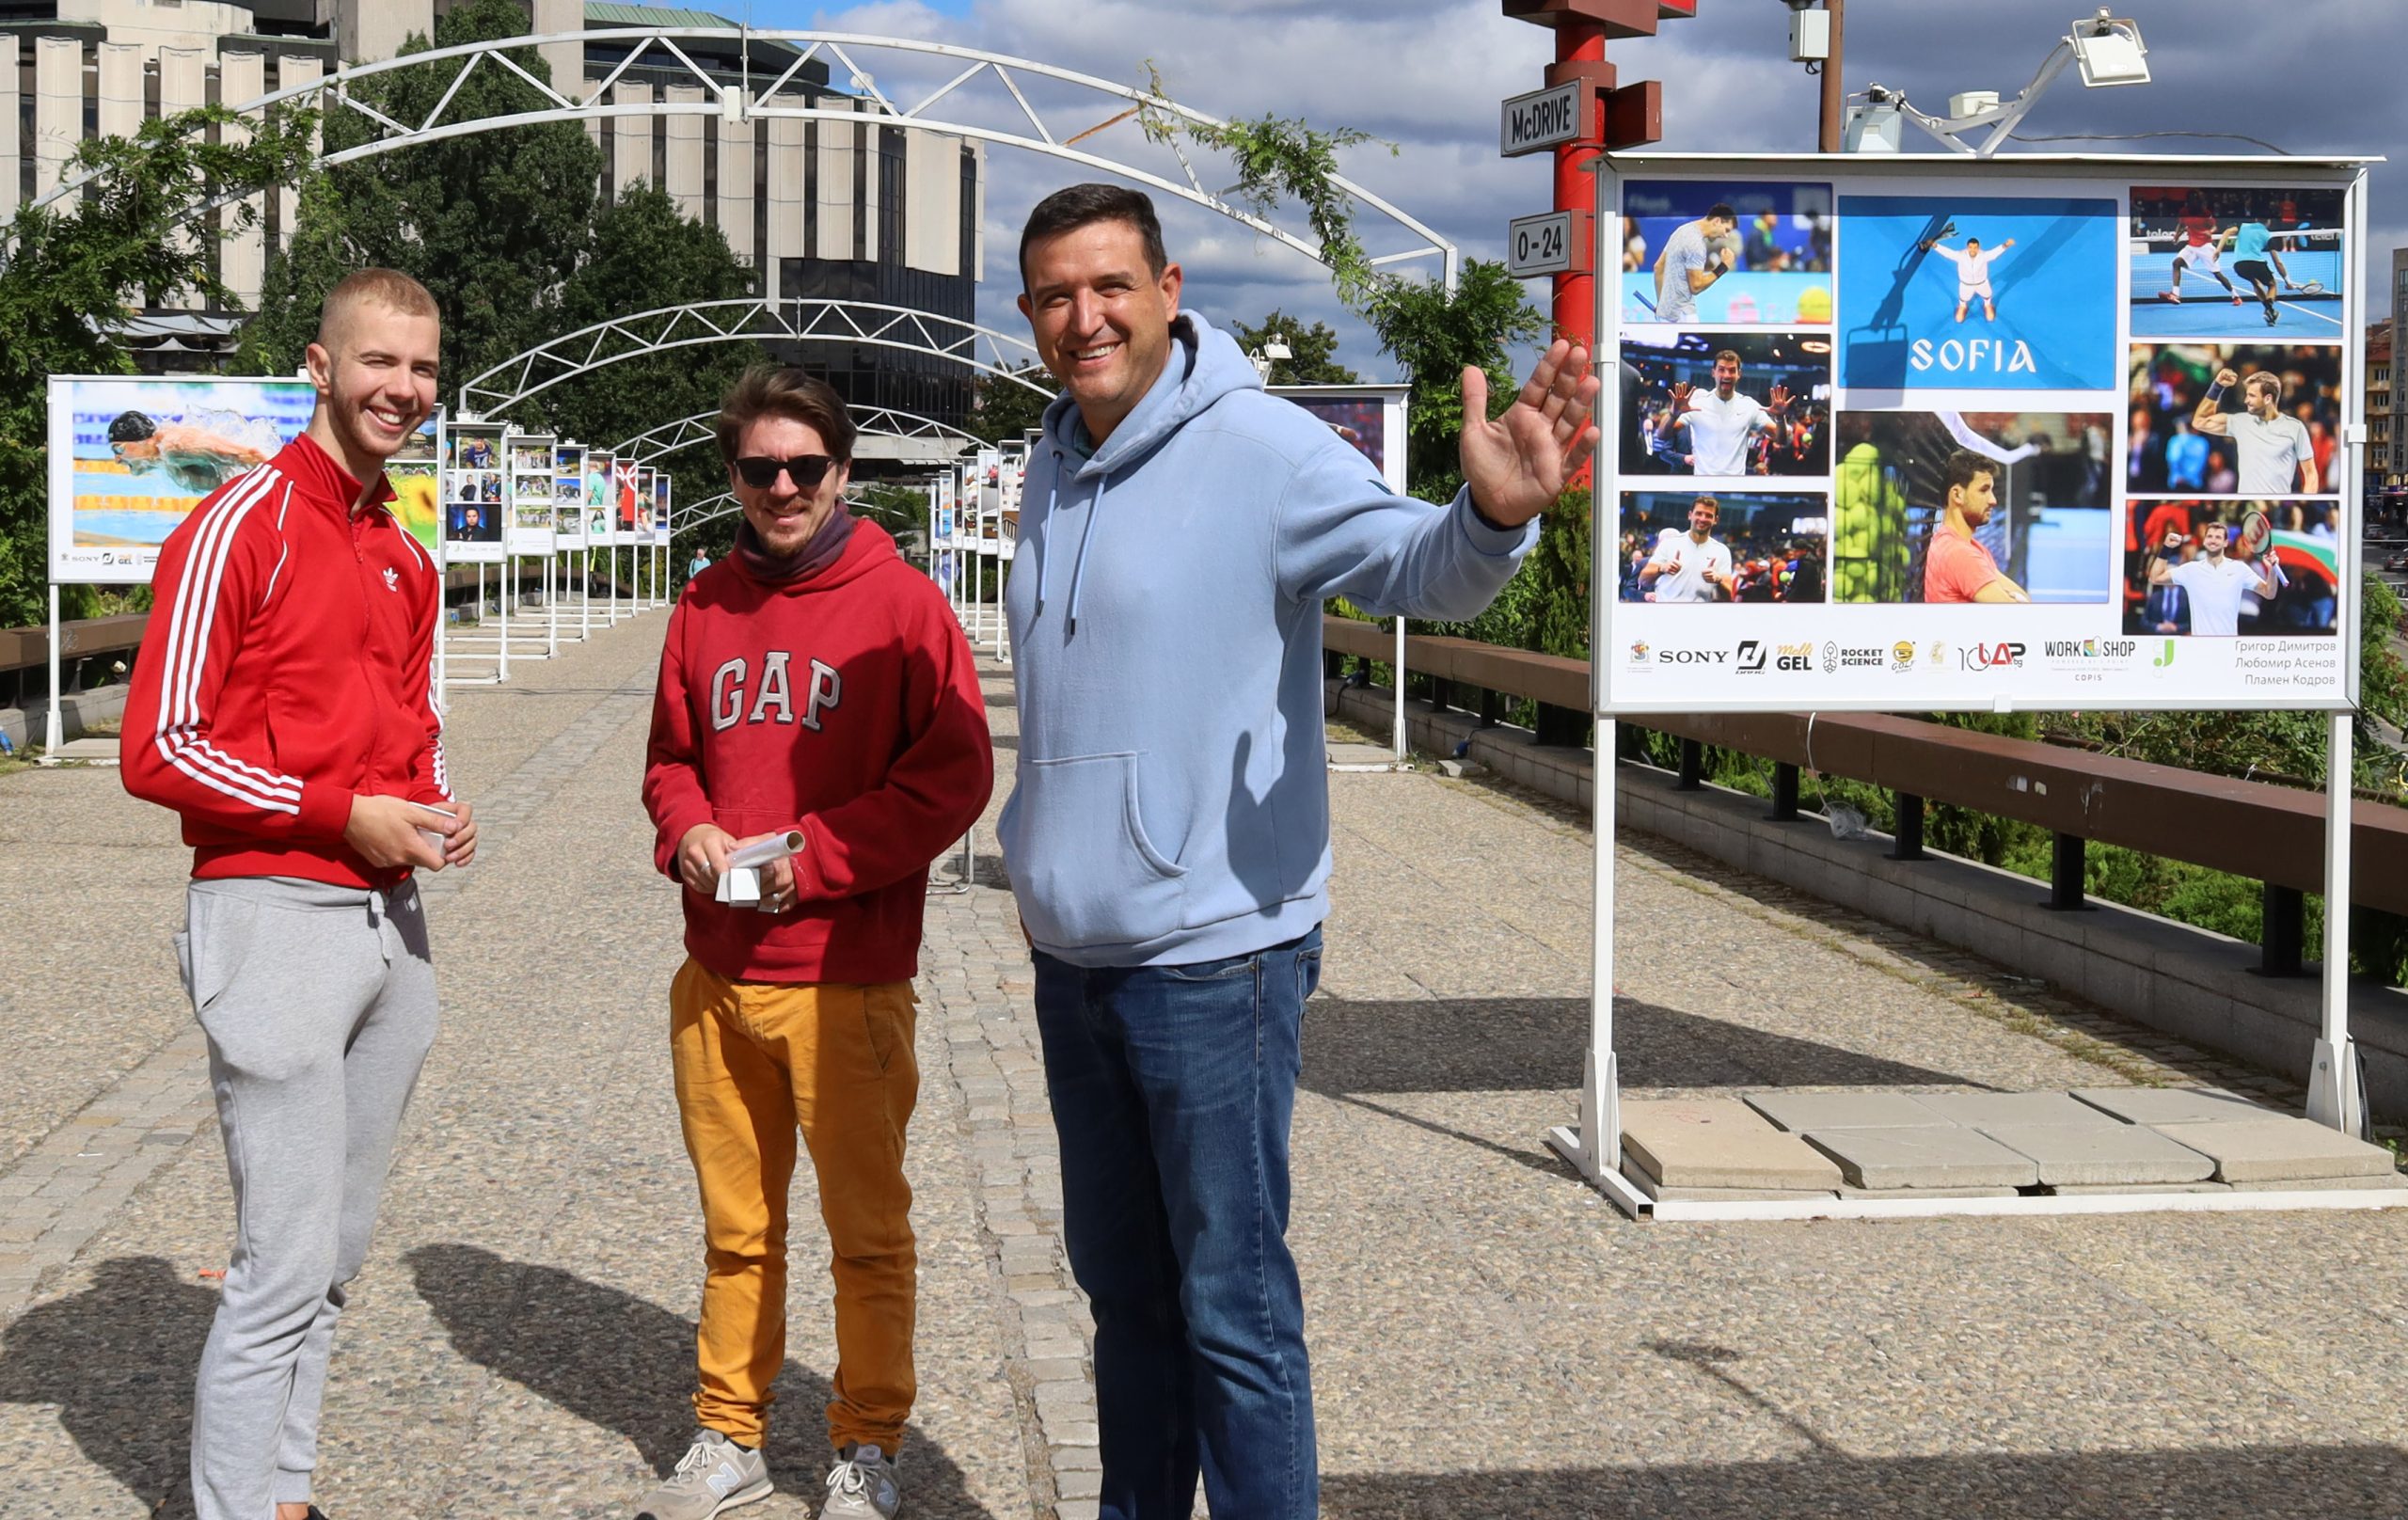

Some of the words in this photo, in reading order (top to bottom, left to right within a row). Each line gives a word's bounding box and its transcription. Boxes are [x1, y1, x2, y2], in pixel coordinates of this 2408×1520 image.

[1512, 95, 1571, 144] McDRIVE
[1909, 339, 2037, 373] SOFIA
[1841, 648, 1883, 657] ROCKET
[2045, 641, 2081, 657] WORK
[2102, 641, 2136, 657] SHOP
[2235, 641, 2275, 653] Григор
[2278, 641, 2337, 653] Димитров
[1658, 650, 1730, 664] SONY
[1776, 656, 1813, 671] GEL
[1841, 657, 1883, 666] SCIENCE
[2235, 657, 2291, 670] Любомир
[2294, 657, 2337, 669] Асенов
[2245, 674, 2289, 685] Пламен
[2292, 674, 2336, 687] Кодров
[711, 650, 841, 732] GAP
